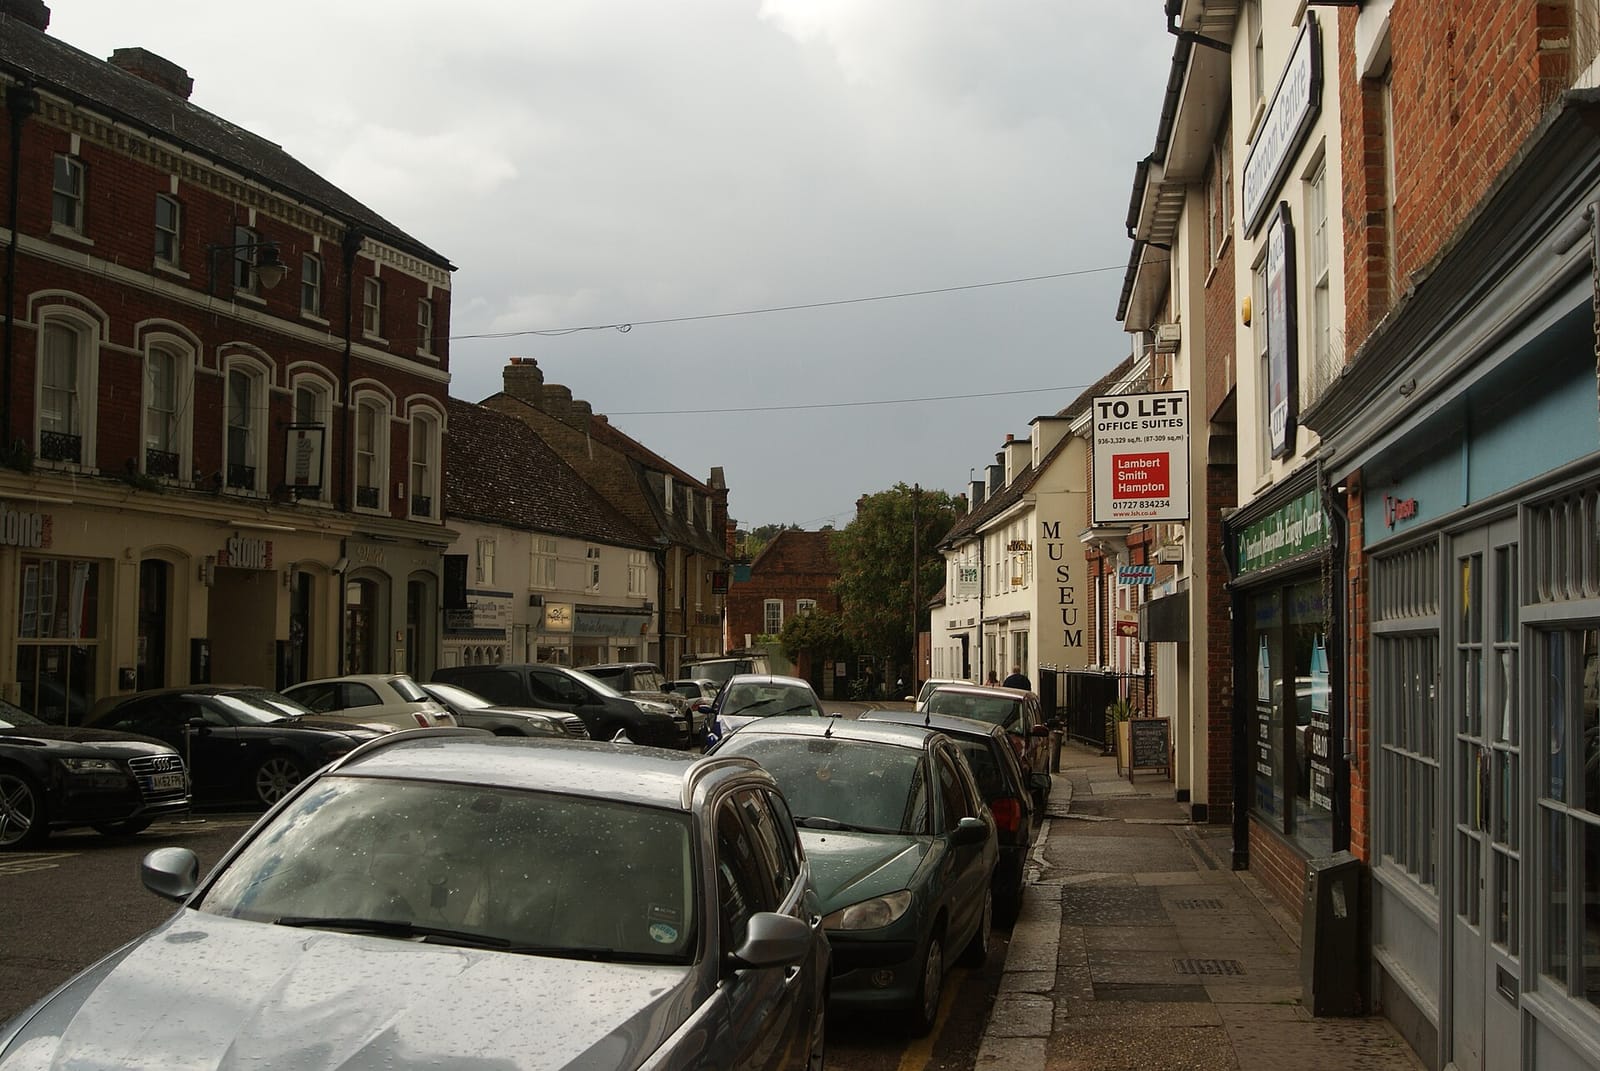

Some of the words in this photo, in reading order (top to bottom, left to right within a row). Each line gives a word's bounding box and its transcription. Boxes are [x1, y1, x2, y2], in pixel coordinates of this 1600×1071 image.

[1248, 122, 1279, 211] Bathroom
[1279, 60, 1305, 141] Centre
[1098, 401, 1129, 419] TO
[1138, 398, 1183, 417] LET
[1098, 421, 1138, 431] OFFICE
[1142, 419, 1184, 429] SUITES
[1118, 458, 1160, 468] Lambert
[1118, 470, 1147, 480] Smith
[1118, 483, 1165, 494] Hampton
[1112, 501, 1137, 509] 01727
[1139, 500, 1170, 508] 834234
[0, 502, 43, 547] tone
[1285, 518, 1303, 547] Energy
[229, 537, 267, 569] stone
[1042, 521, 1083, 648] MUSEUM
